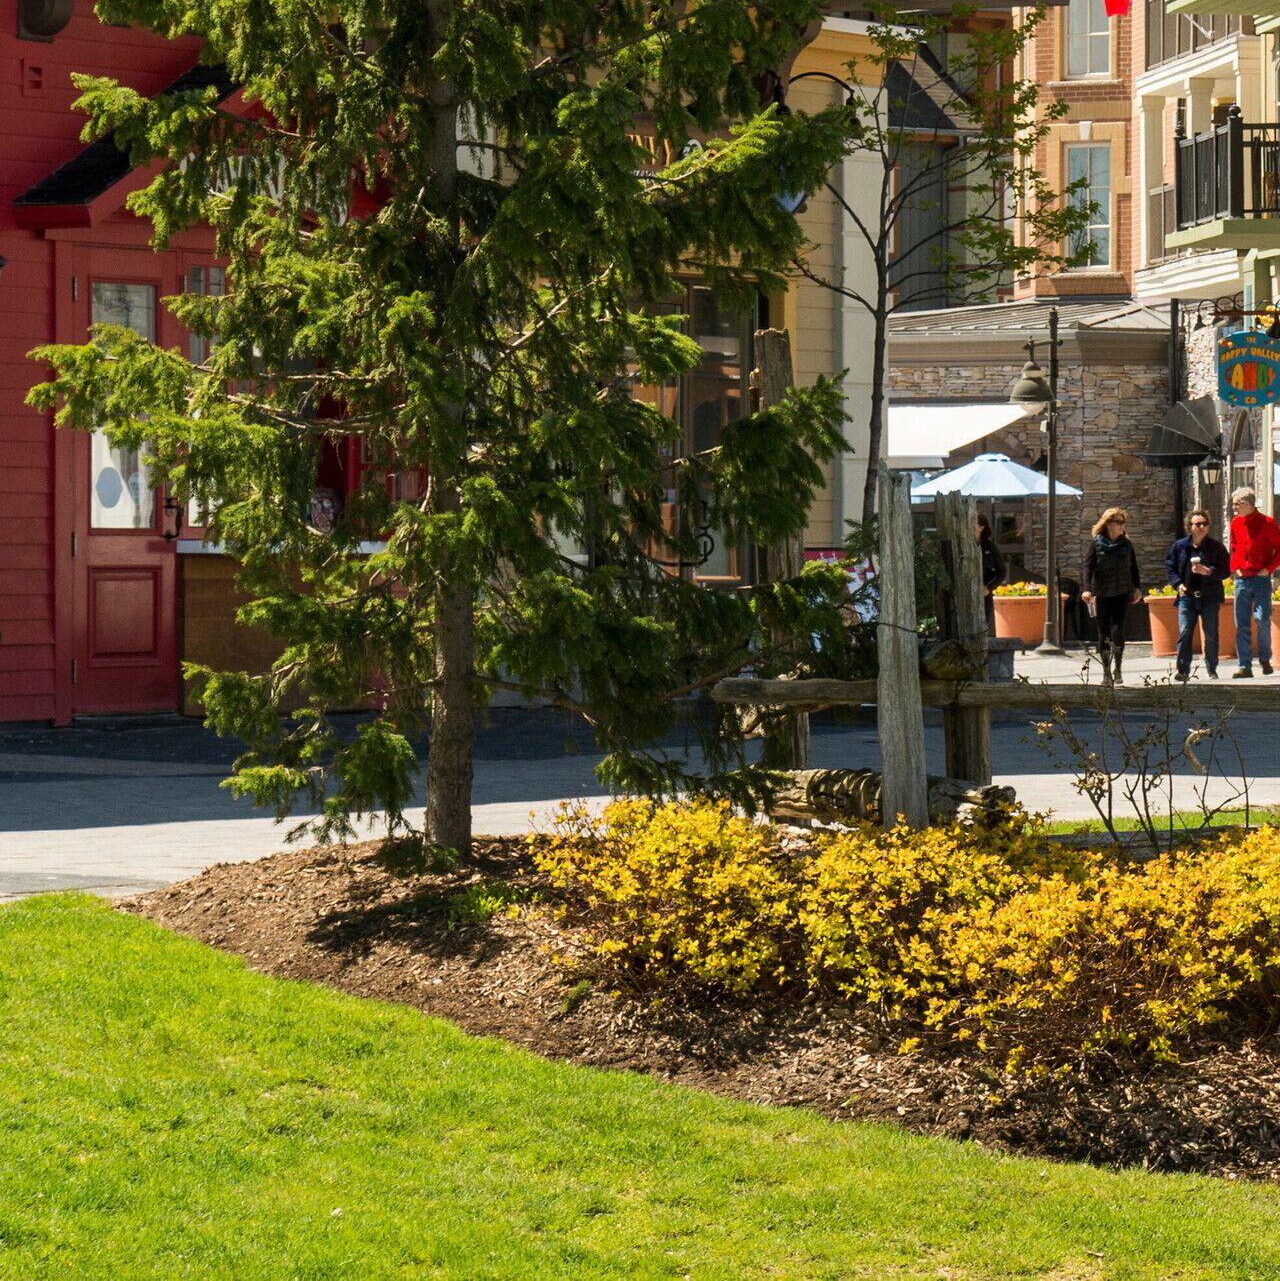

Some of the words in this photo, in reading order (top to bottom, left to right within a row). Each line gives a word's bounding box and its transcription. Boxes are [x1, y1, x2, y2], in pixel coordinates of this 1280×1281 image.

[1220, 347, 1247, 364] HAPPY
[1250, 347, 1280, 361] VALLEY
[1225, 361, 1275, 392] CANDY
